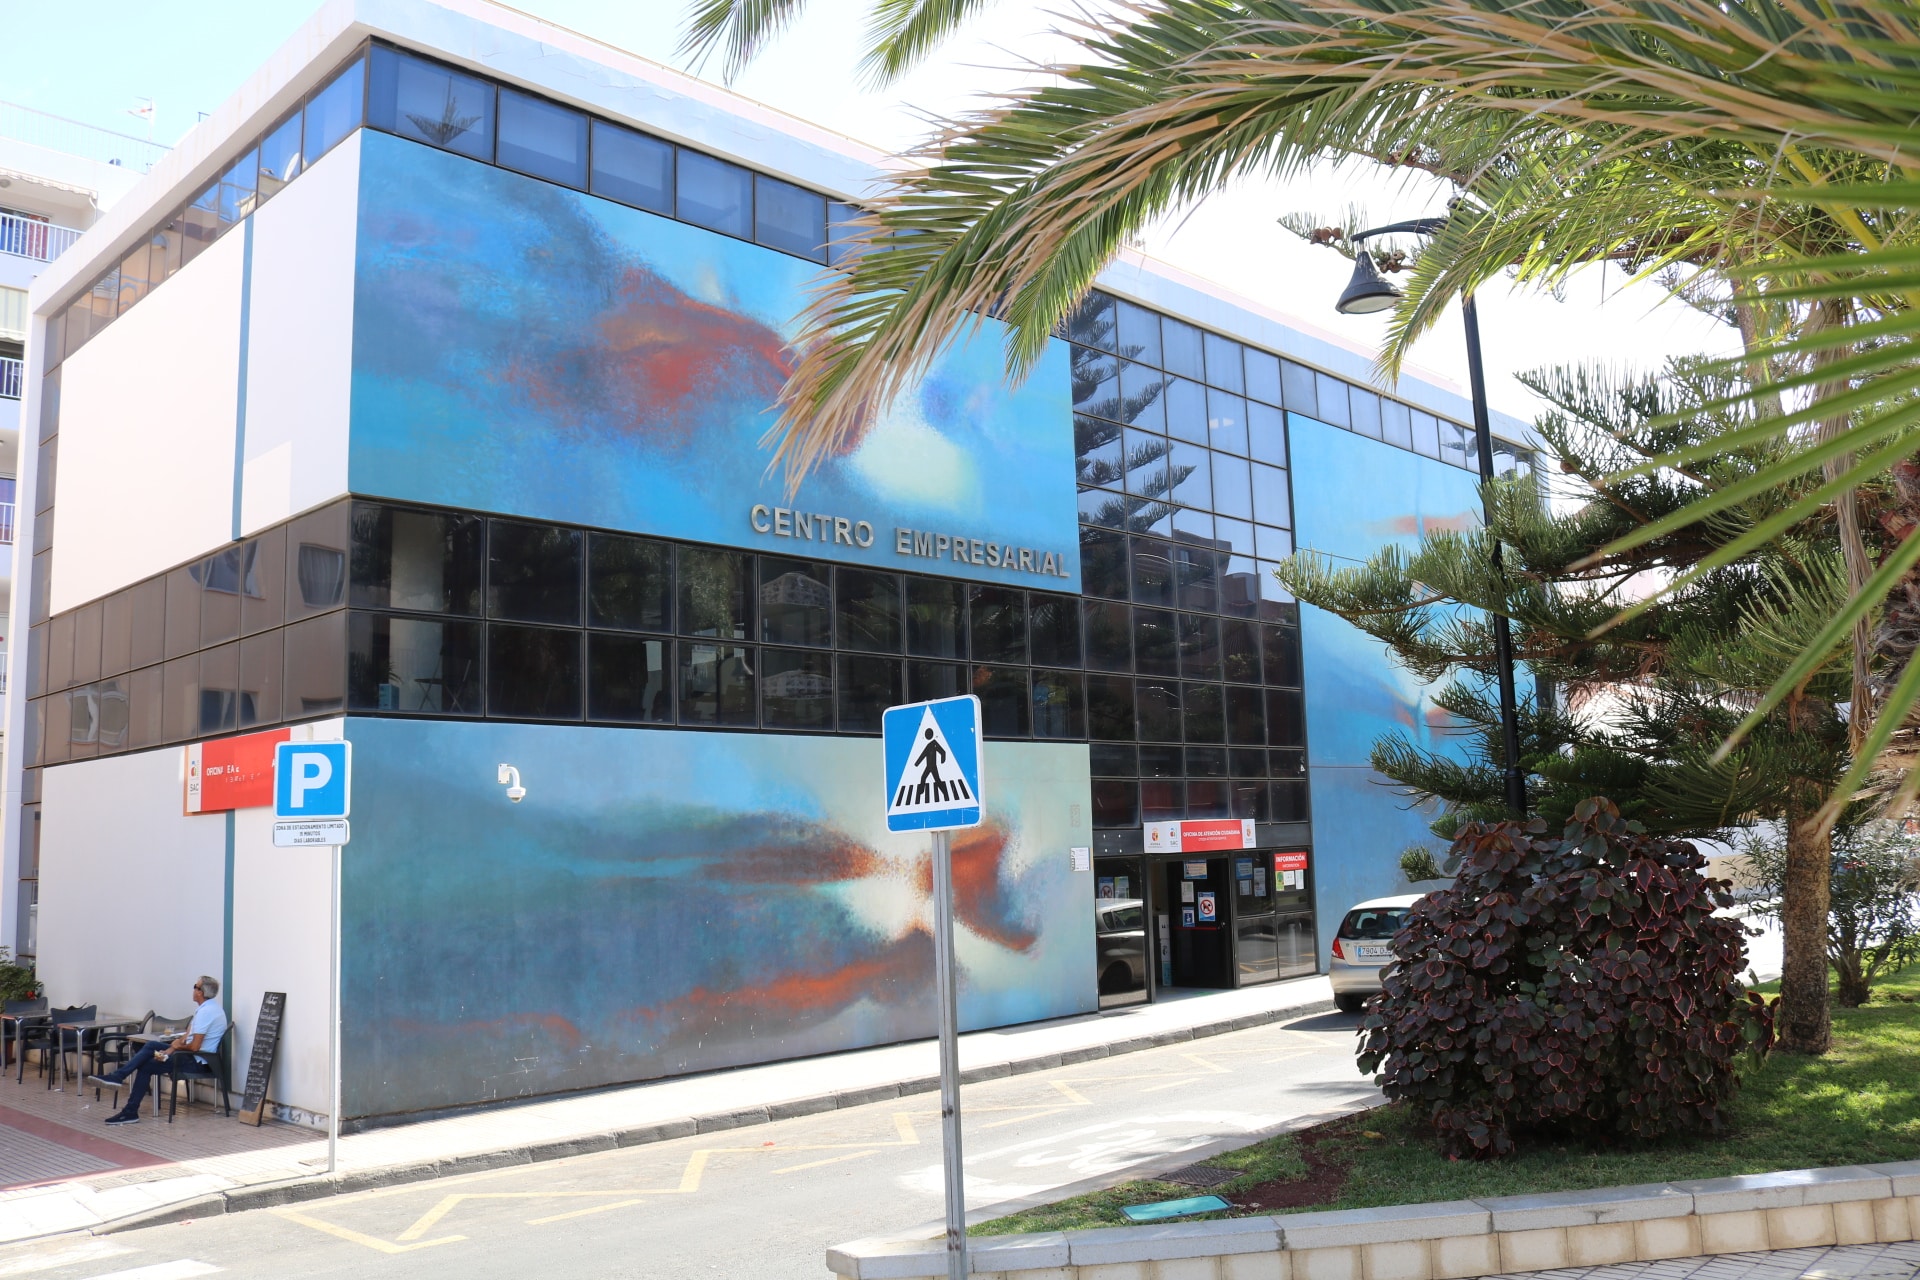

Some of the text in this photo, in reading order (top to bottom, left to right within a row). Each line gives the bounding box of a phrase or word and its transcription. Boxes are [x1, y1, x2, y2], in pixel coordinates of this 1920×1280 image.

[751, 504, 1070, 578] CENTRO EMPRESARIAL
[291, 752, 332, 807] P
[1275, 853, 1305, 862] INFORMACIÓN
